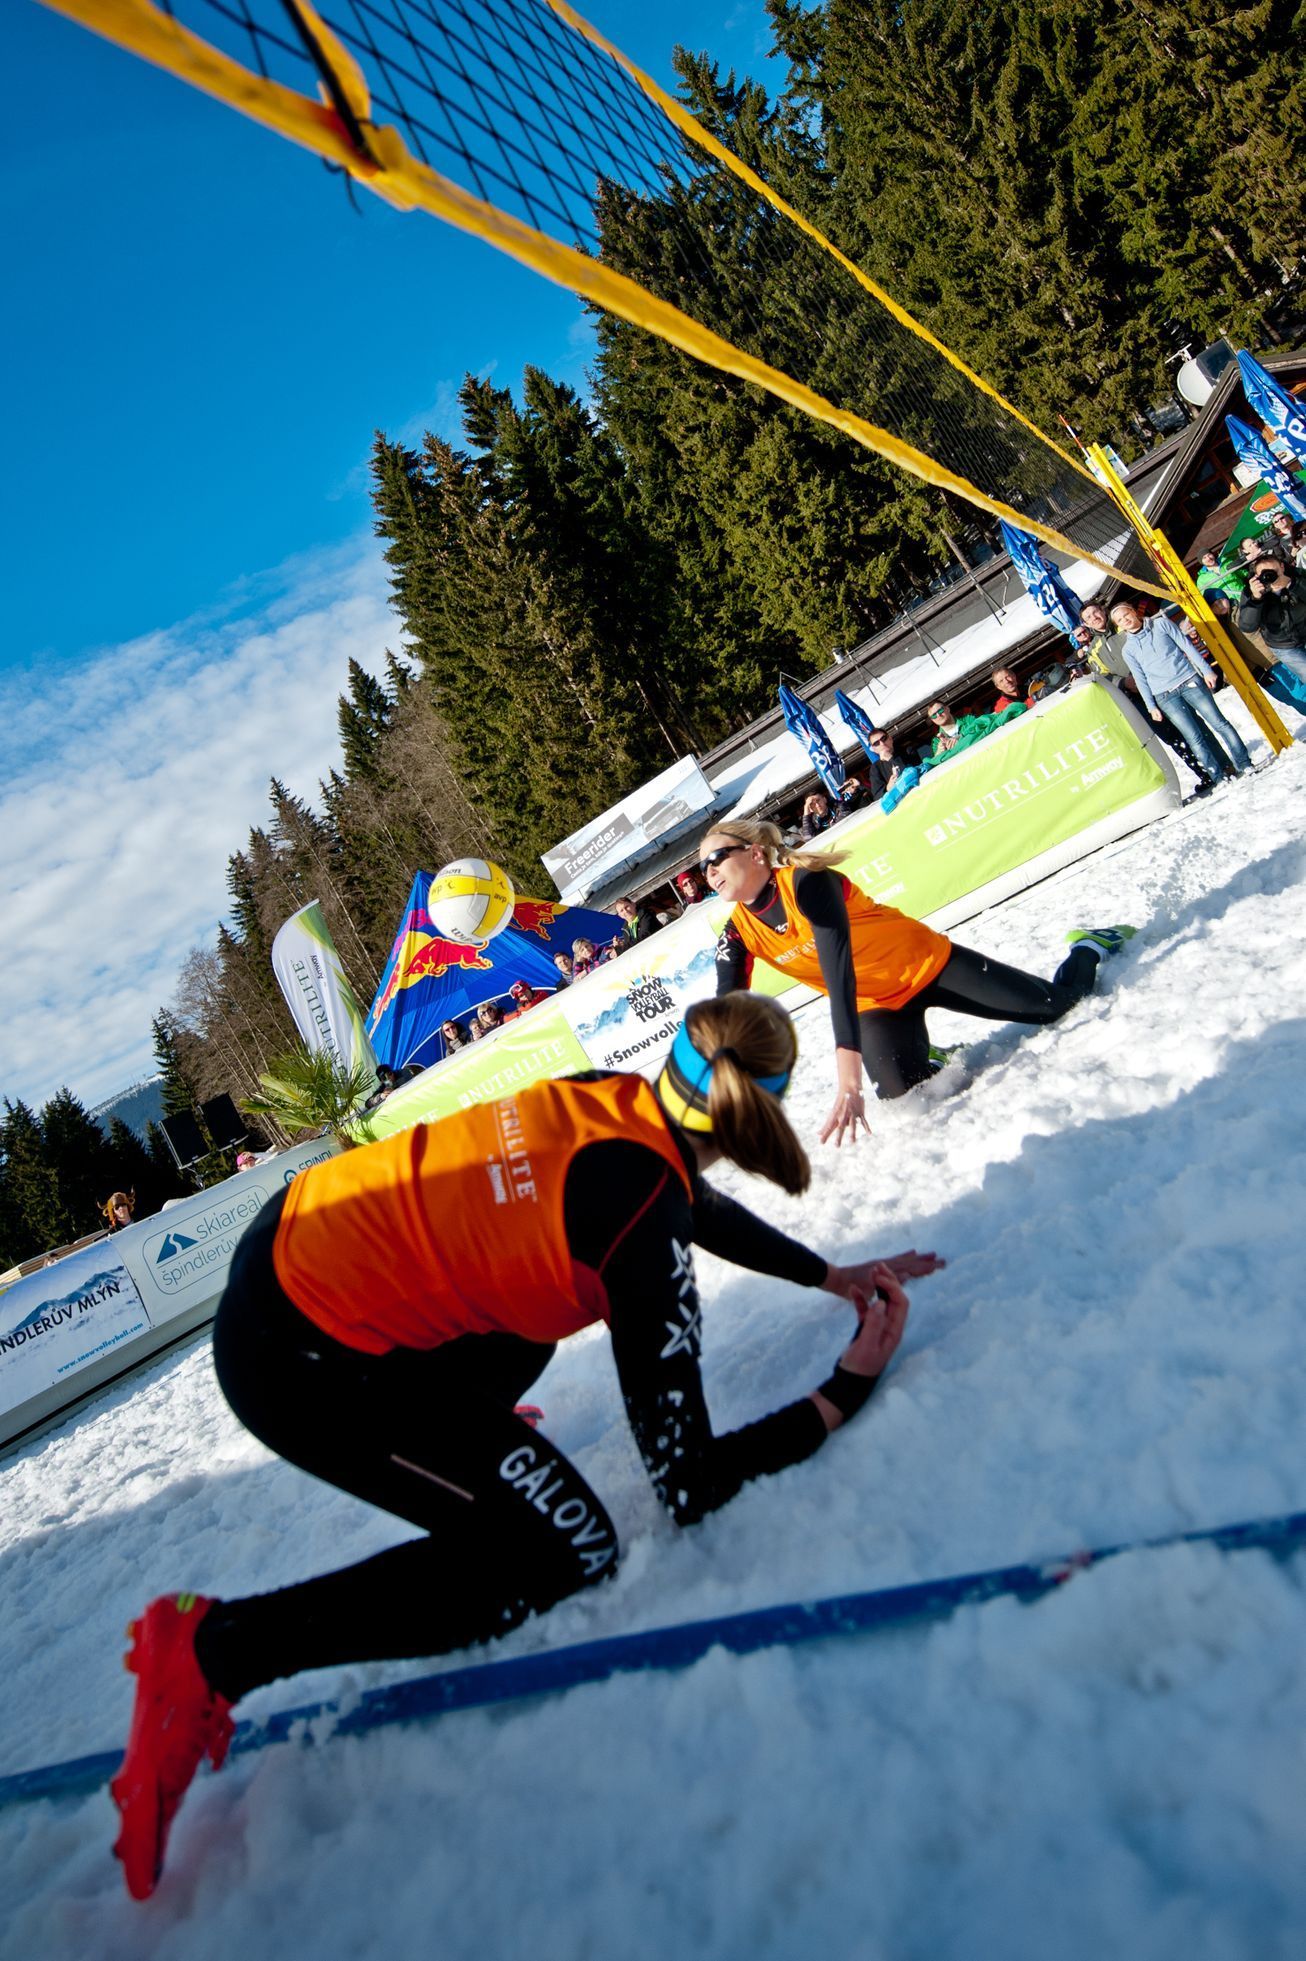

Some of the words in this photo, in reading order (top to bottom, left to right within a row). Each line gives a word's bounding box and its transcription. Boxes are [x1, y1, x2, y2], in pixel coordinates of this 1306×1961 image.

[943, 727, 1111, 836] NUTRILITE
[564, 826, 616, 875] Freerider
[626, 976, 663, 1005] SNOW
[630, 987, 669, 1012] VOLLEYBALL
[636, 996, 676, 1023] TOUR
[468, 1038, 566, 1103] NUTRILITE
[499, 1096, 536, 1200] UTRILITE
[196, 1192, 263, 1240] skiareál
[0, 1305, 73, 1355] NDLERŮV
[78, 1281, 121, 1313] MLÝN
[57, 1322, 143, 1374] www.snowvolleyball.com
